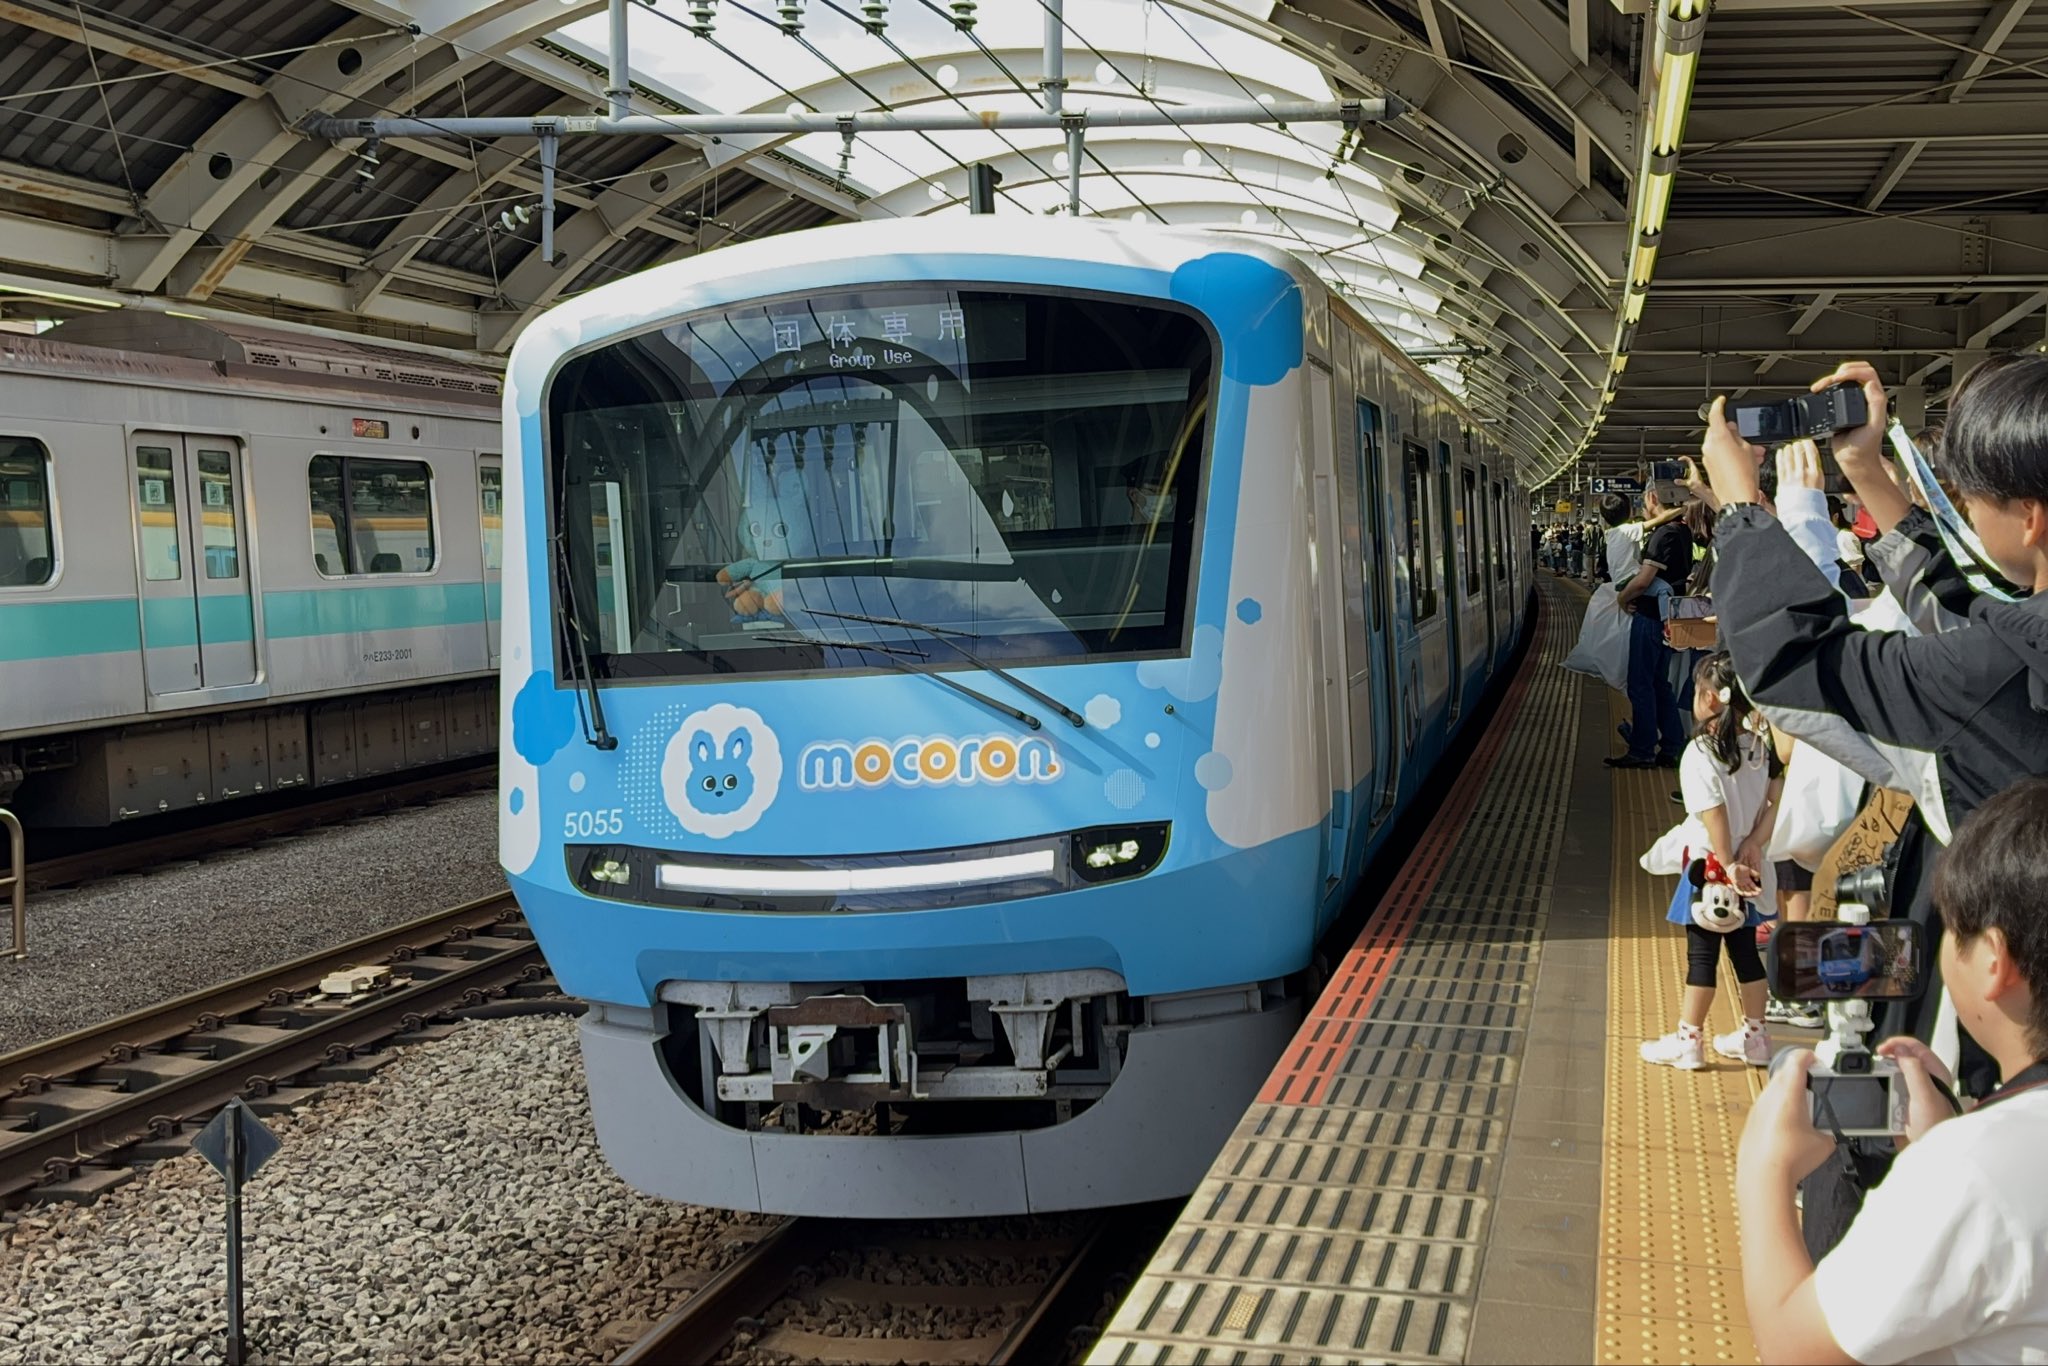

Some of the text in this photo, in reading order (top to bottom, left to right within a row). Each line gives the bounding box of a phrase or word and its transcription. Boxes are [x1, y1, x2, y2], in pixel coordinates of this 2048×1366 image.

[772, 309, 967, 353] 団体専用
[829, 349, 913, 370] Group Use
[1594, 478, 1605, 493] 3
[563, 808, 624, 838] 5055
